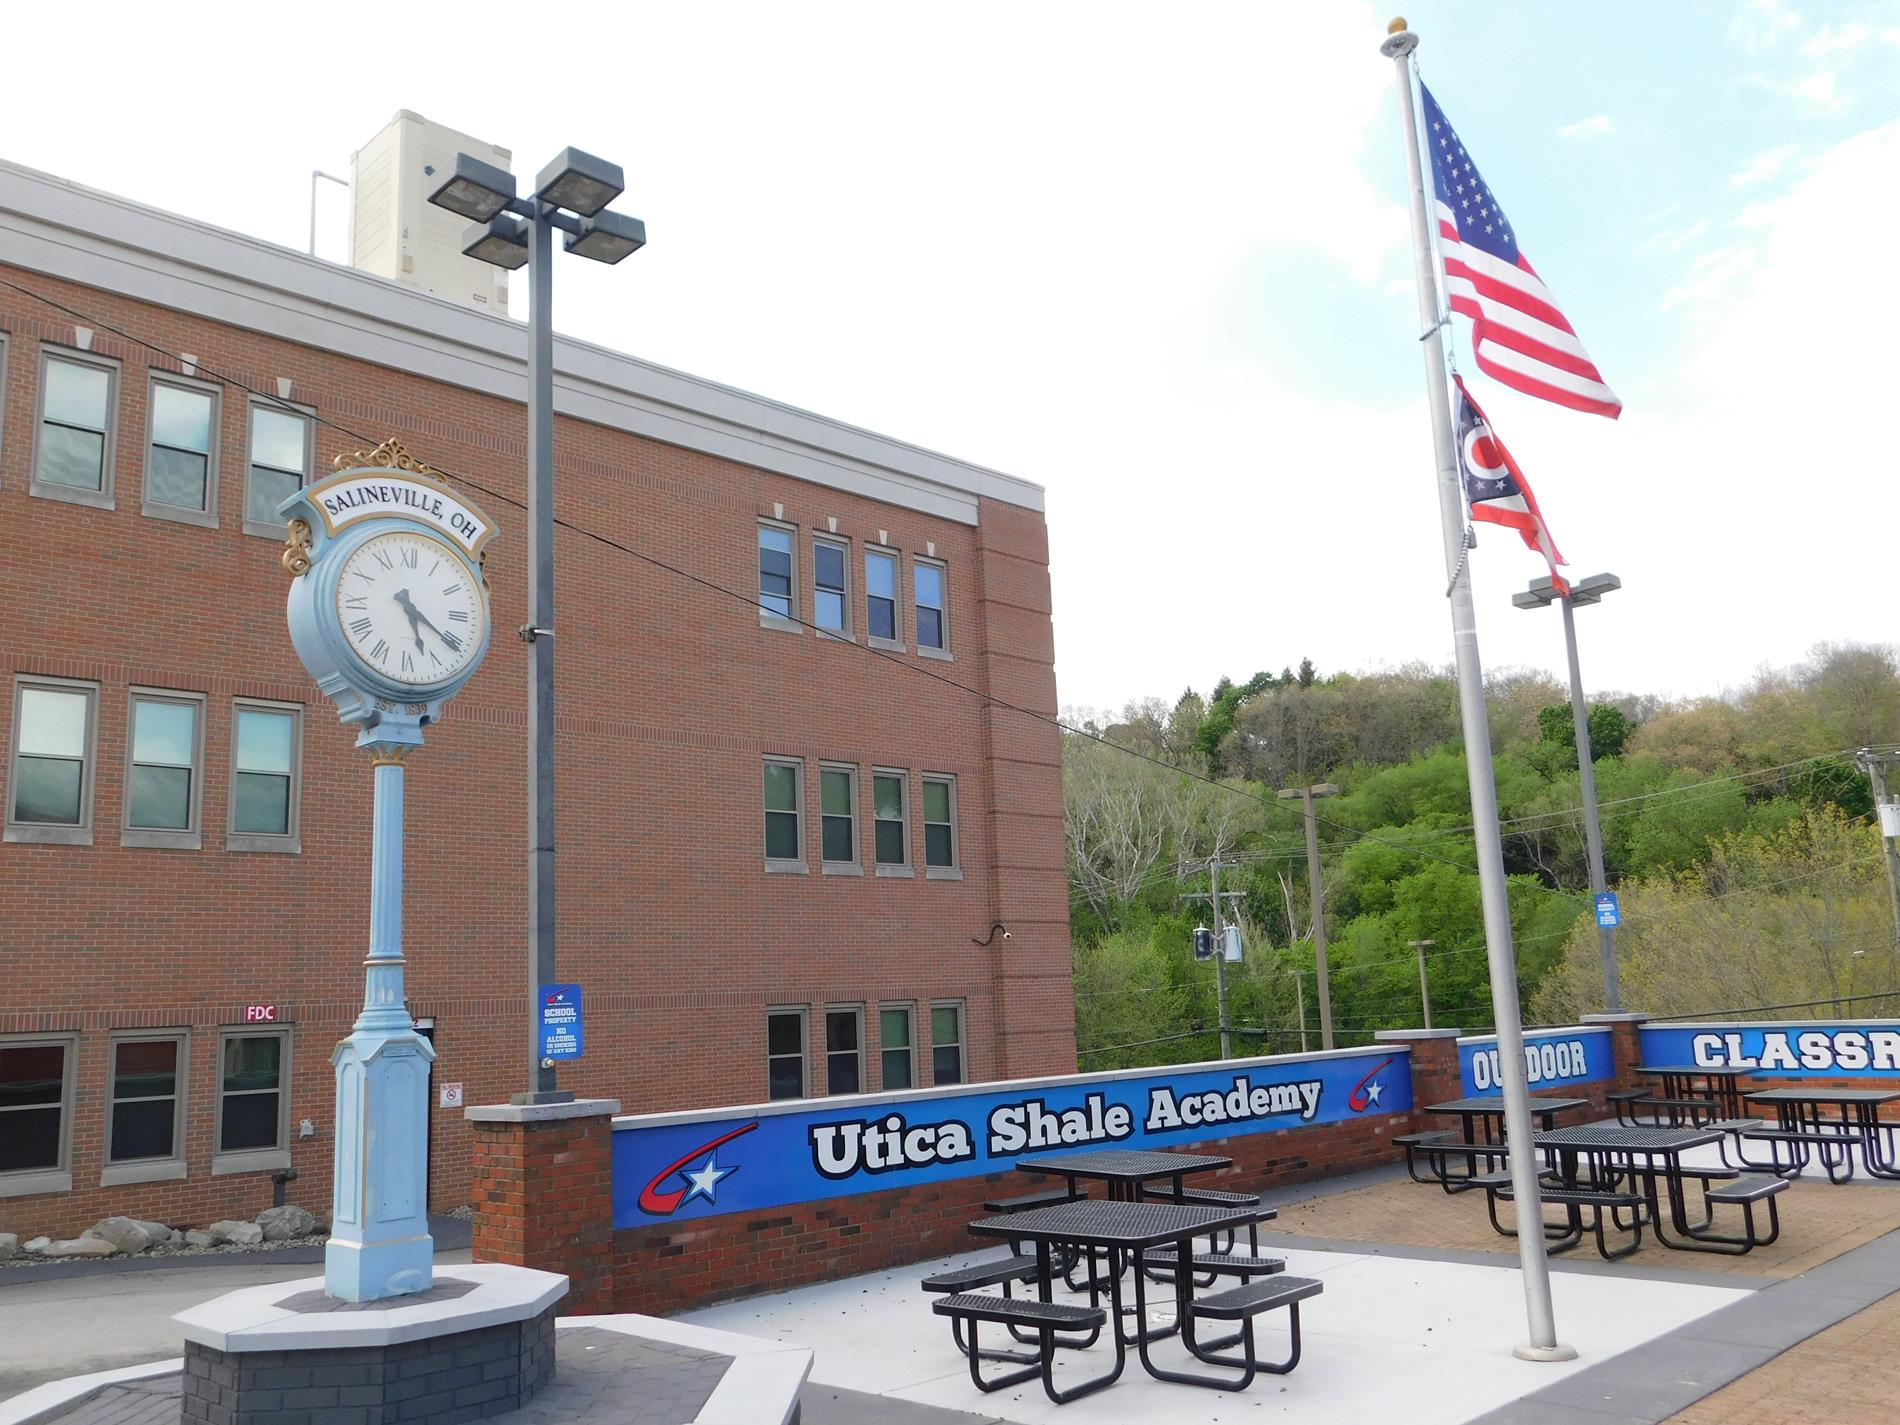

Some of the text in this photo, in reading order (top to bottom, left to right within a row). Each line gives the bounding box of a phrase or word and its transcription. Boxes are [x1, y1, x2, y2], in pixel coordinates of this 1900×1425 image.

[324, 485, 477, 540] SALINEVILLE, OH
[247, 1005, 275, 1020] FDC
[544, 1008, 576, 1017] SCHOOL
[1472, 1040, 1587, 1090] OUDOOR
[811, 1078, 1322, 1176] Utica Shale Academy
